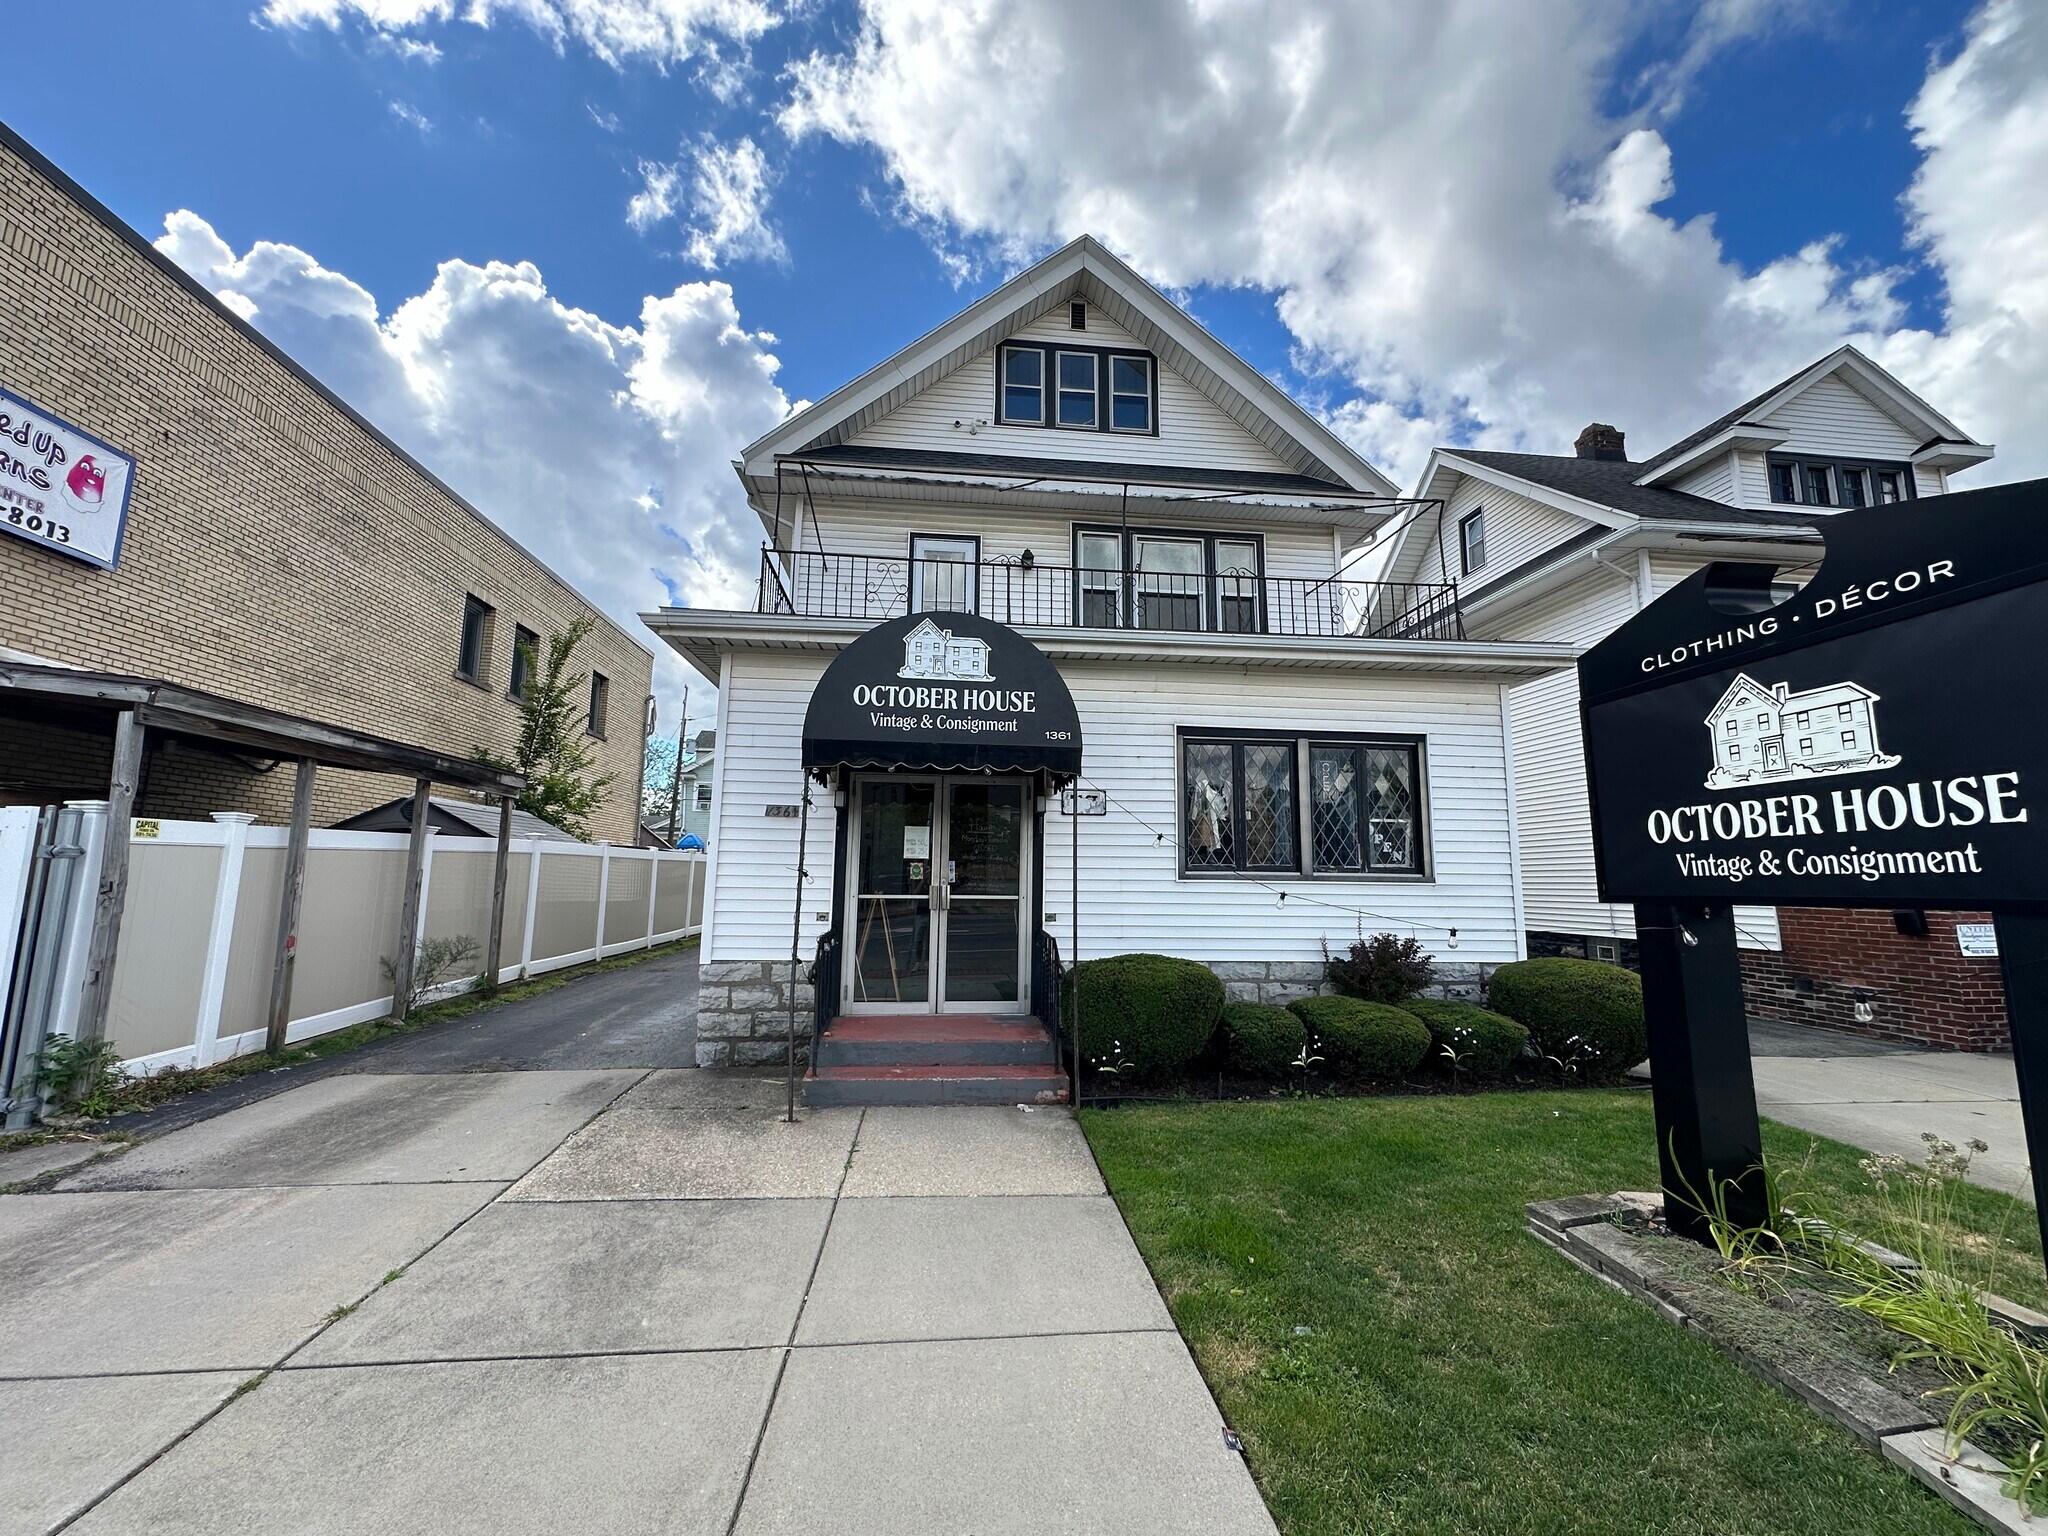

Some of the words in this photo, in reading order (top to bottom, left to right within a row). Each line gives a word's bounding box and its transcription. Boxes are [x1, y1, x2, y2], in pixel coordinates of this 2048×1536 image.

[0, 485, 44, 513] NTER
[1641, 617, 1778, 672] CLOTHING
[1815, 560, 1955, 619] DÉCOR
[852, 684, 958, 710] OCTOBER
[963, 689, 1036, 713] HOUSE
[870, 712, 918, 732] Vintage
[920, 713, 934, 729] &
[936, 714, 1018, 734] Consignment
[1044, 731, 1071, 741] 1361
[1647, 794, 1824, 844] OCTOBER
[1830, 771, 2028, 833] HOUSE
[136, 820, 159, 831] CAPITAL
[1676, 849, 1753, 882] Vintage
[1758, 849, 1782, 876] &
[1786, 842, 1983, 882] Consignment
